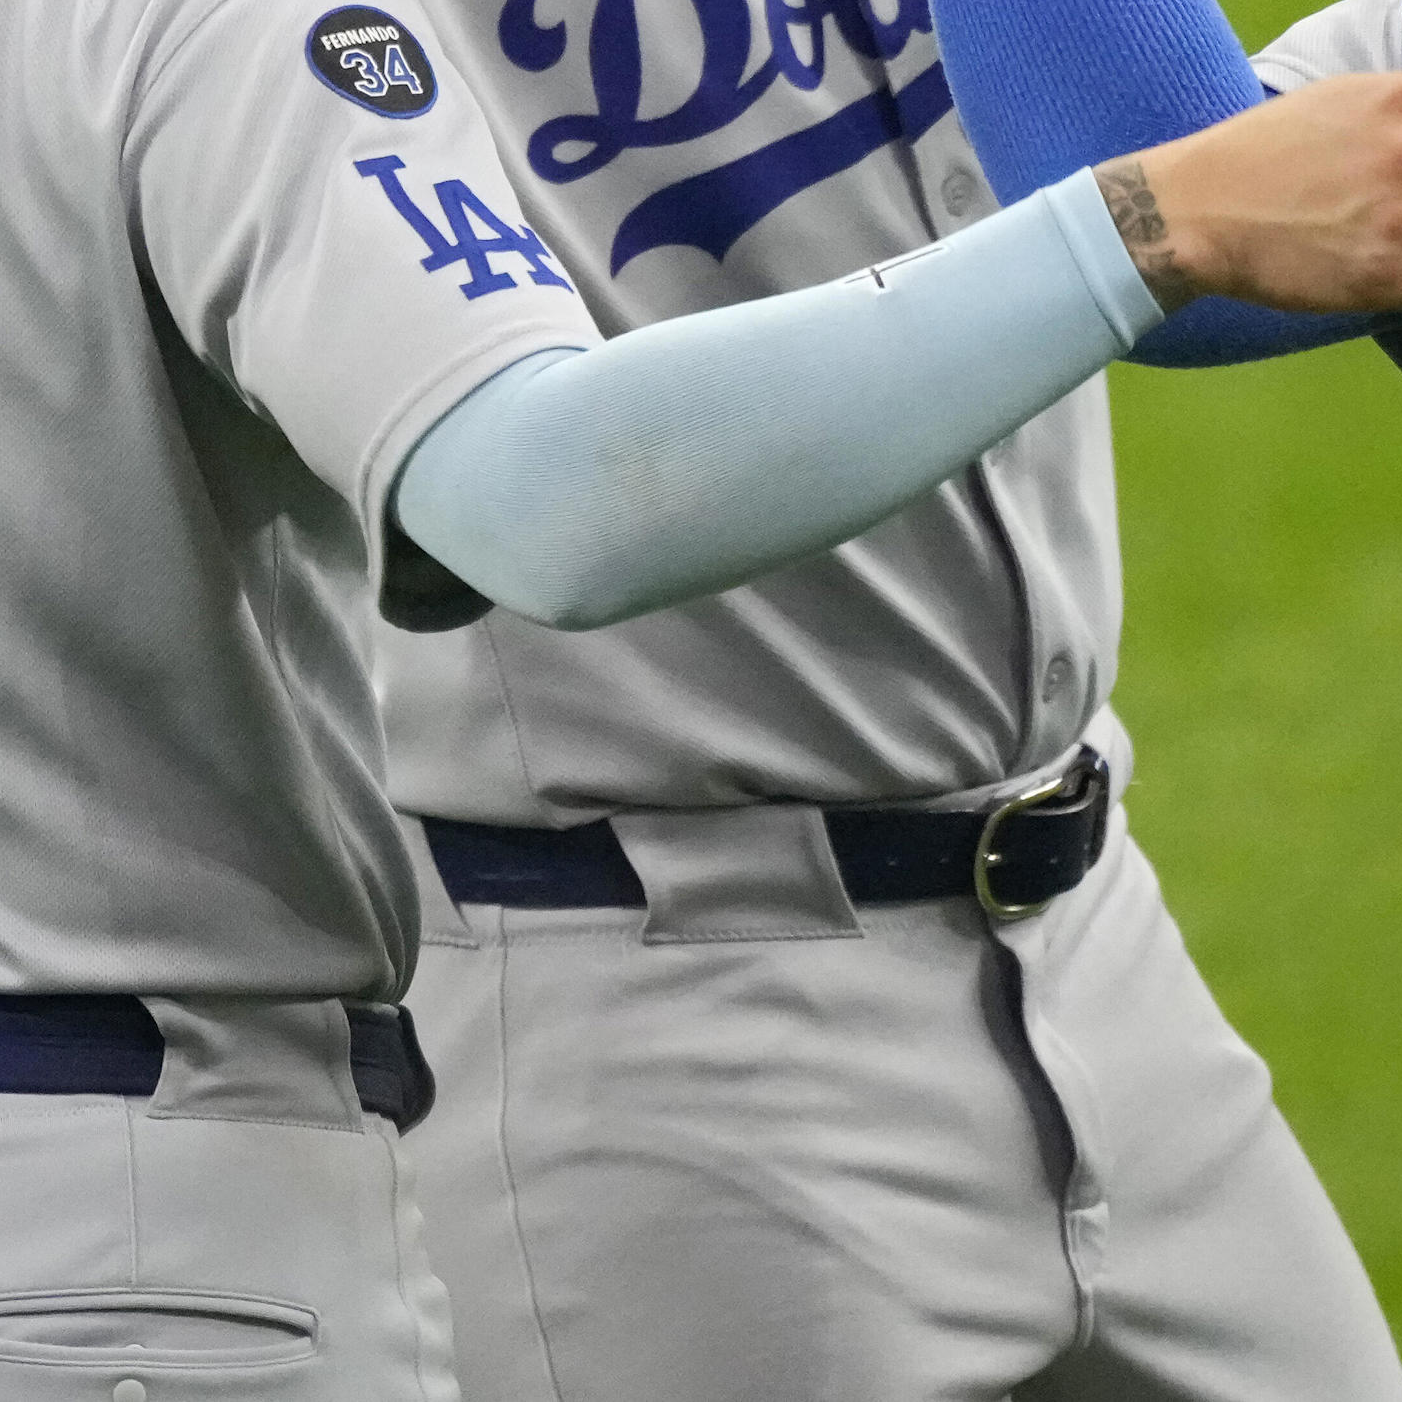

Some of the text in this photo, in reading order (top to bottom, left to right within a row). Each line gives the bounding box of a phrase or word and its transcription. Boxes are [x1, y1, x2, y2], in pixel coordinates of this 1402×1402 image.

[320, 25, 400, 51] FERNANDO
[340, 44, 424, 97] 34
[353, 154, 574, 301] LA
